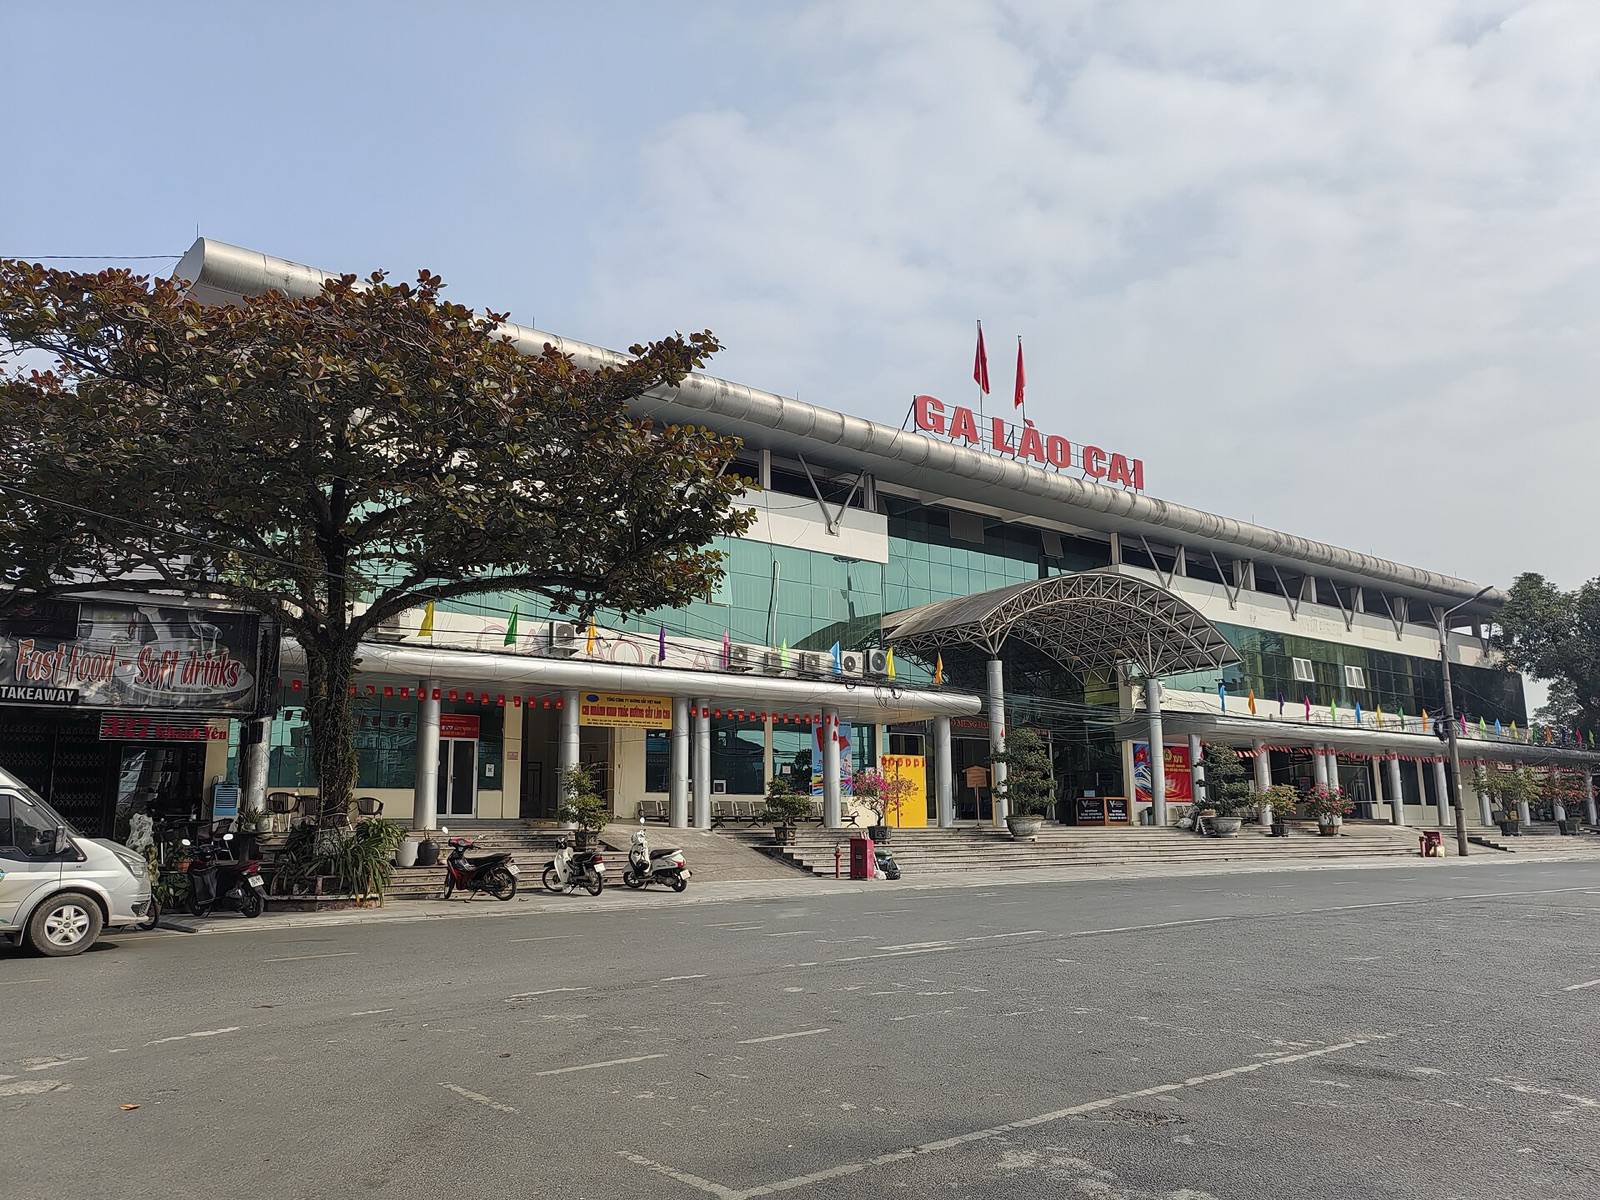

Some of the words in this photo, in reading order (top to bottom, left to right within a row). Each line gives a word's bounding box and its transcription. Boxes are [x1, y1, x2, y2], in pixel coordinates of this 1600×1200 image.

[915, 395, 979, 444] GA
[992, 417, 1071, 469] LÀO
[1083, 446, 1144, 490] CAI
[15, 638, 66, 688] Fast
[66, 642, 117, 688] food
[134, 645, 180, 690] Soft
[180, 649, 241, 688] drinks
[0, 686, 75, 702] TAKEAWAY
